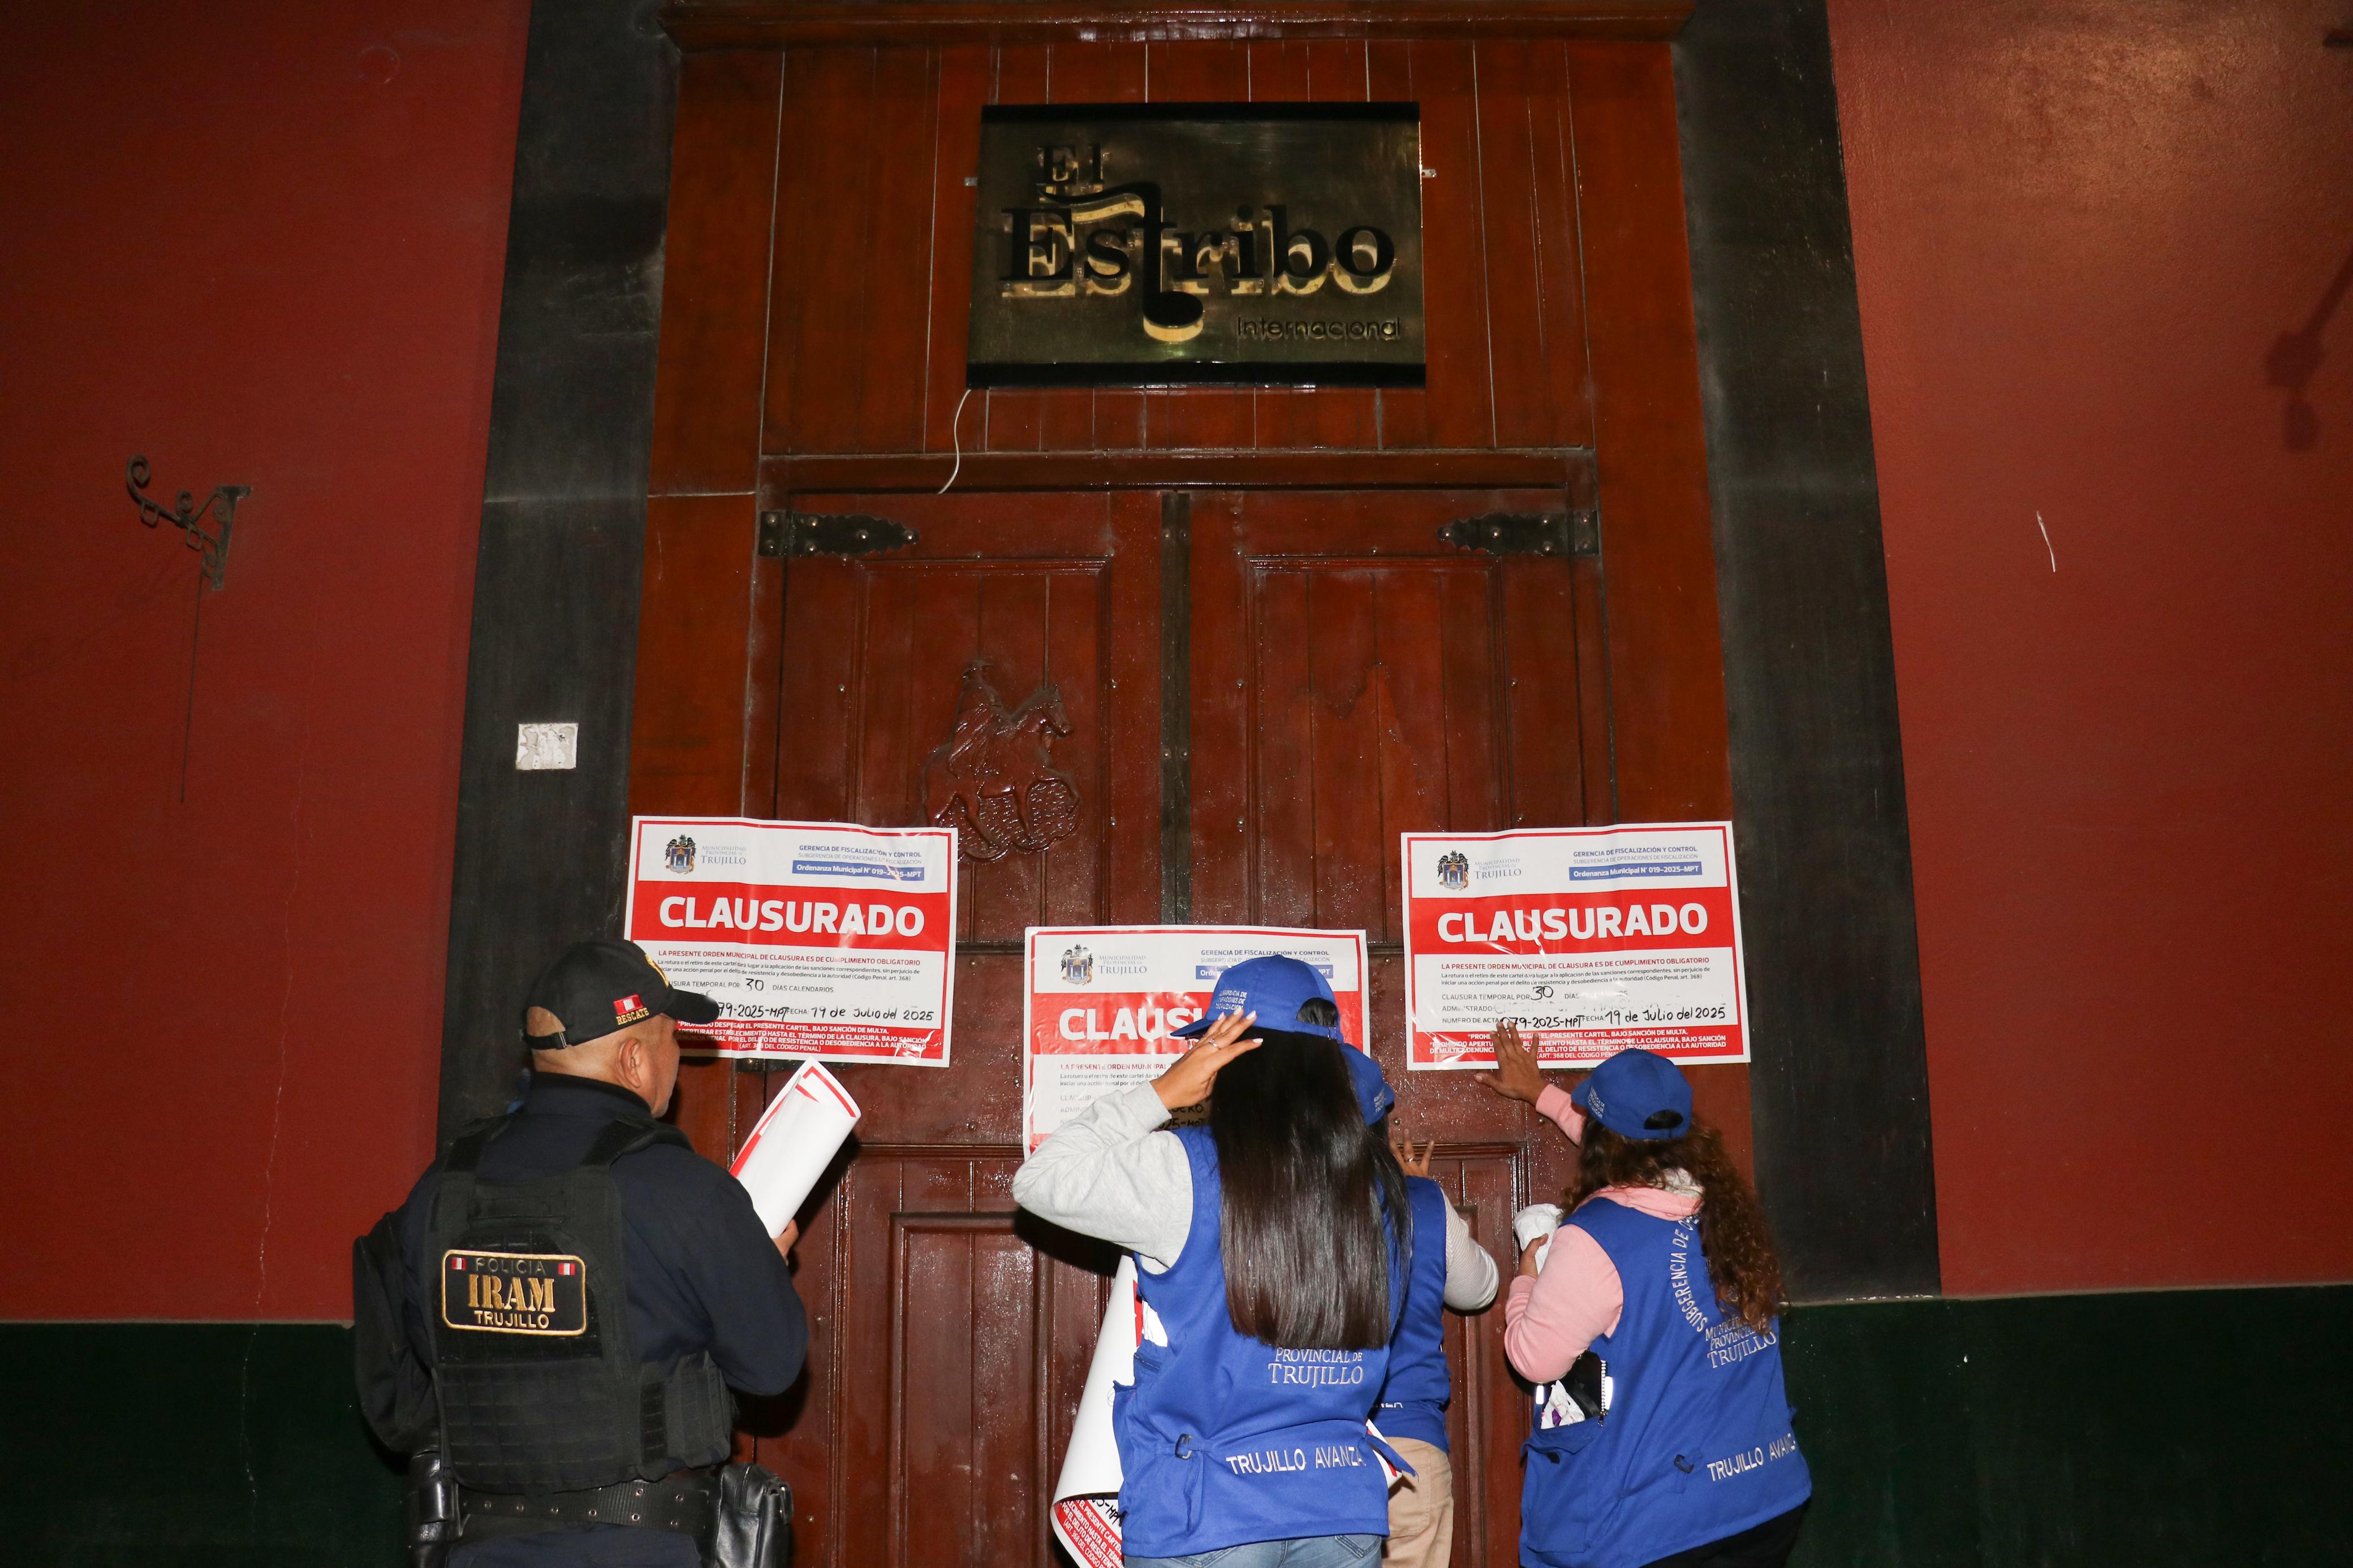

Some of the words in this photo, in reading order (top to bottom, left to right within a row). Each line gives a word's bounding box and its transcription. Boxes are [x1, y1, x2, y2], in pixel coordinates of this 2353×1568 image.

[1037, 143, 1104, 185] El
[1001, 182, 1395, 328] Estribo
[1237, 317, 1400, 337] Internacional
[700, 855, 747, 865] TRUJILLO
[1474, 869, 1522, 879] TRUJILLO
[659, 896, 925, 938] CLAUSURADO
[1437, 902, 1709, 944] CLAUSURADO
[1098, 965, 1147, 975] TRUJILLO
[744, 978, 764, 992] 30
[1531, 986, 1553, 1000] 30
[615, 1008, 649, 1025] RESCATE
[811, 1007, 826, 1018] 19
[830, 1005, 846, 1018] de
[853, 1007, 880, 1018] Julio
[884, 1007, 897, 1020] del
[903, 1010, 934, 1021] 2025
[1605, 1010, 1620, 1025] 19
[1626, 1010, 1638, 1022] de
[1643, 1009, 1673, 1021] Julio
[1677, 1007, 1692, 1019] del
[1695, 1007, 1726, 1019] 2025
[1673, 1229, 1689, 1249] DE
[475, 1258, 546, 1275] POLICIA
[468, 1274, 555, 1313] IRAM
[1670, 1252, 1708, 1332] SUBGERENCIA
[473, 1310, 549, 1329] TRUJILLO
[1275, 1347, 1350, 1363] PROVINCIAL
[1352, 1353, 1363, 1362] DE
[1707, 1331, 1776, 1368] TRUJILLO
[1268, 1363, 1364, 1388] TRUJILLO
[1226, 1448, 1307, 1475] TRUJILLO
[1706, 1447, 1764, 1481] TRUJILLO
[1072, 1517, 1087, 1537] DELITO
[1084, 1506, 1105, 1535] PRESENTE
[1087, 1527, 1102, 1545] HASTA
